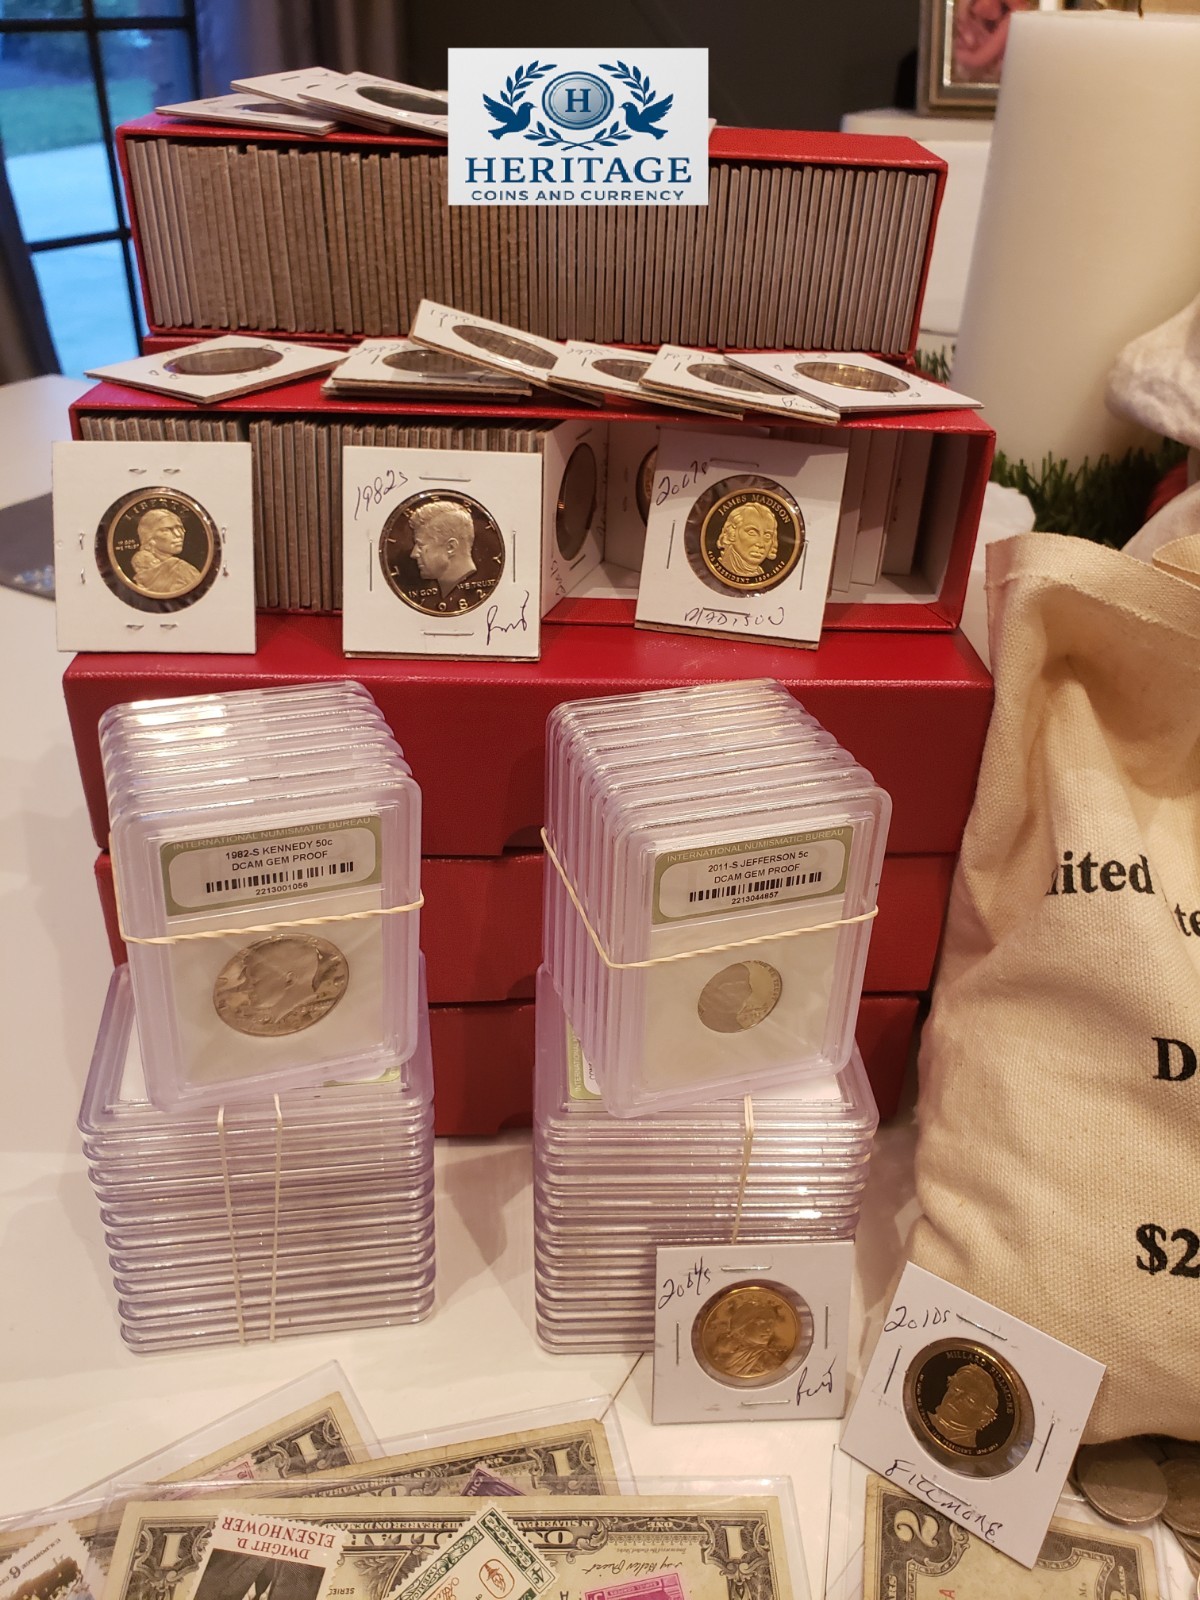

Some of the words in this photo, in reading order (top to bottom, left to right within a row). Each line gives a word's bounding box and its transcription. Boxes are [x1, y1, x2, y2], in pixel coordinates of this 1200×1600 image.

[718, 494, 748, 516] JAMES
[751, 493, 791, 524] MADISON
[173, 832, 259, 850] INTERNATIONAL
[260, 824, 327, 839] NUMISMATIC
[329, 817, 371, 830] BUREAU
[225, 848, 260, 861] 1982-S
[262, 840, 313, 856] KENNEDY
[316, 838, 333, 848] 50c
[667, 843, 742, 863] INTERNATIONAL
[744, 834, 804, 850] NUMISMATIC
[805, 829, 844, 841] BUREAU
[232, 858, 264, 871] DCAM
[266, 855, 290, 867] GEM
[293, 851, 328, 863] PROOF
[708, 861, 739, 873] 2011-S
[740, 852, 796, 868] JEFFERSON
[798, 850, 809, 859] 5c
[714, 872, 742, 884] DCAM
[744, 869, 766, 880] GEM
[768, 863, 801, 876] PROOF
[1044, 850, 1156, 897] ited
[255, 881, 309, 897] 2213001056
[945, 1351, 987, 1367] MILLARD
[989, 1366, 1014, 1415] FILLMORE
[221, 1516, 337, 1548] EISENHOWER
[375, 1521, 392, 1529] ON
[393, 1521, 442, 1529] BEARER
[537, 1520, 580, 1528] SILVER
[581, 1520, 594, 1528] IN
[893, 1510, 940, 1548] 2
[160, 1532, 189, 1568] 1
[237, 1537, 248, 1548] D.
[251, 1540, 311, 1560] DWIGHT
[460, 1543, 470, 1553] OF
[488, 1517, 533, 1566] POSTAGE
[721, 1526, 746, 1560] 1
[9, 1565, 21, 1579] 6
